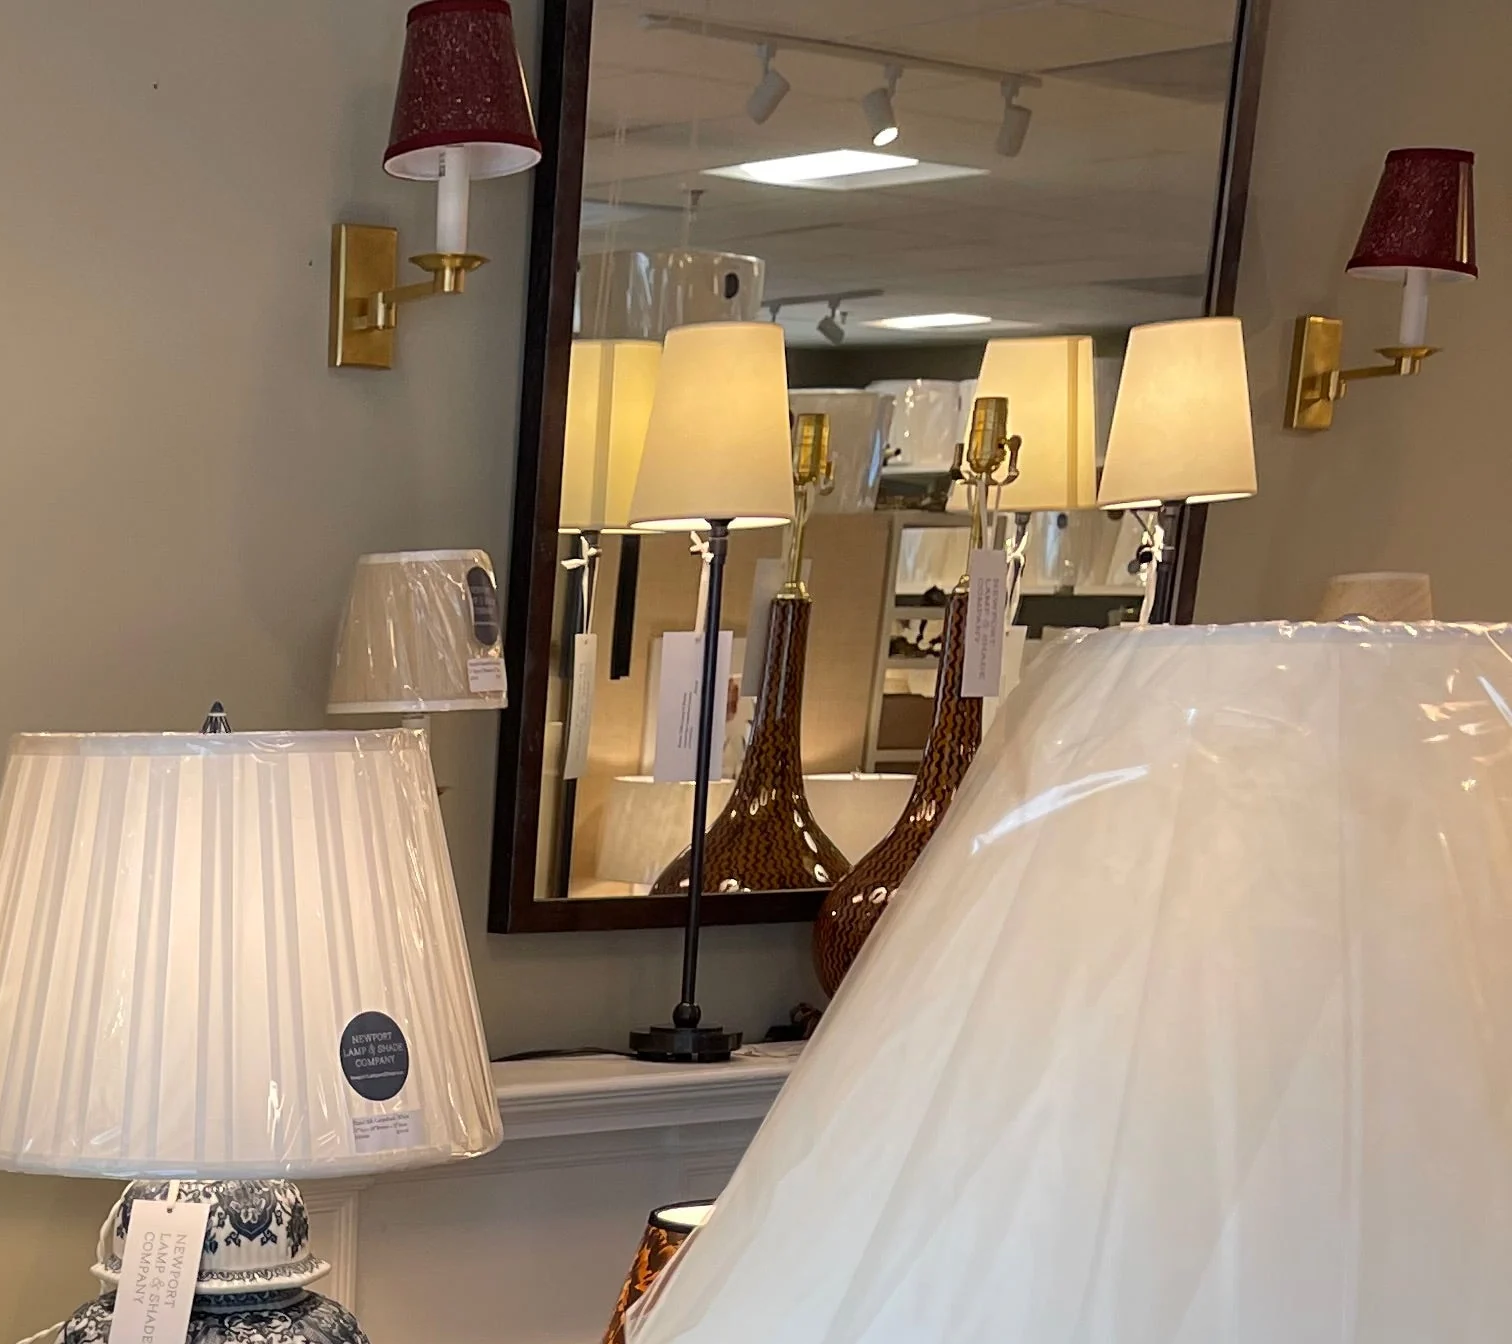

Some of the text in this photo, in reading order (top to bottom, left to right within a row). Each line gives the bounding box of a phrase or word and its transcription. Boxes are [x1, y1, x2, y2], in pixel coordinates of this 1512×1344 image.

[343, 1048, 366, 1057] LAMP
[377, 1043, 404, 1053] SHADE
[351, 1032, 392, 1044] NEWPORT
[355, 1055, 396, 1067] COMPANY
[133, 1231, 155, 1305] COMPANY
[142, 1233, 172, 1344] LAMP & SHADE
[164, 1234, 188, 1309] NEWPORT
